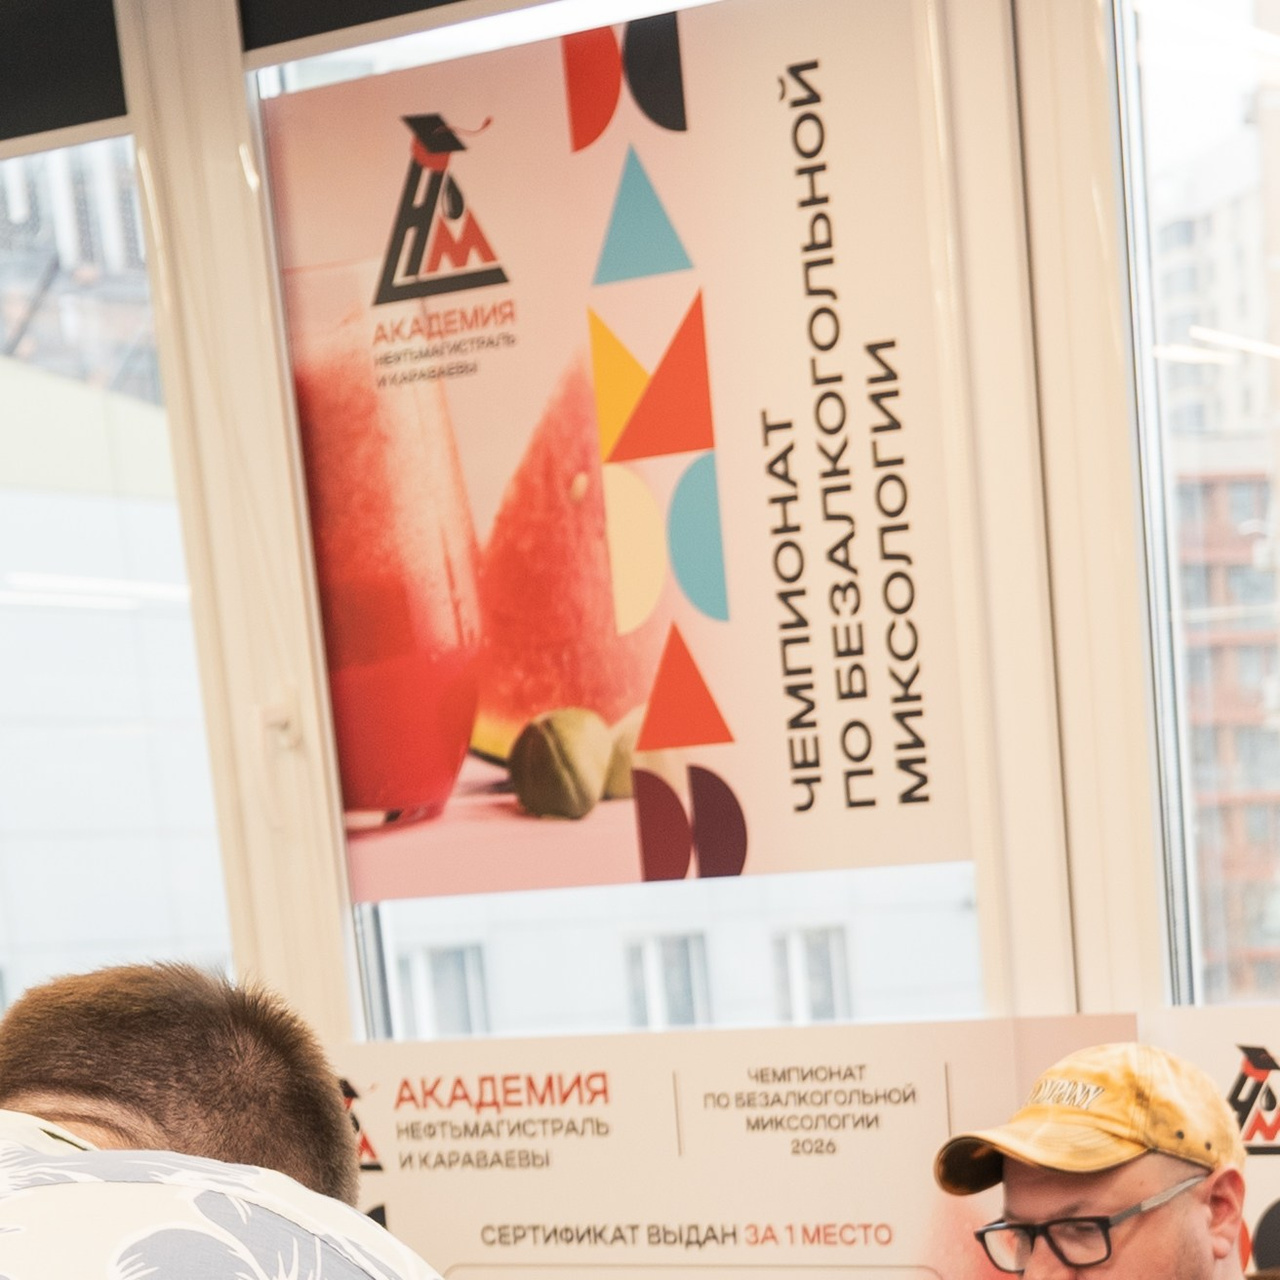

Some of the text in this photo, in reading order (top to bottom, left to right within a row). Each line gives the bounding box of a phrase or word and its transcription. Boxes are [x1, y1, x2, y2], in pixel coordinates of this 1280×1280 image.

[372, 299, 516, 346] АКАДЕМИЯ
[778, 59, 877, 808] ПО БЕЗАЛКОГОЛЬНОЙ
[864, 340, 931, 805] МИКСОЛОГИИ
[761, 408, 822, 812] ЧЕМПИОНАТ
[748, 1065, 866, 1084] ЧЕМПИОНАТ
[394, 1072, 611, 1114] АКАДЕМИЯ
[704, 1083, 917, 1110] ПО БЕЗАЛКОГОЛЬНОЙ
[396, 1117, 610, 1141] НЕФТЬМАГИСТРАЛЬ
[746, 1113, 879, 1132] МИКСОЛОГИИ
[400, 1149, 550, 1170] И КАРАВАЕВЫ
[791, 1138, 837, 1155] 2026
[481, 1223, 894, 1249] СЕРТИФИКАТ ВЫДАН ЗА 1 МЕСТО
